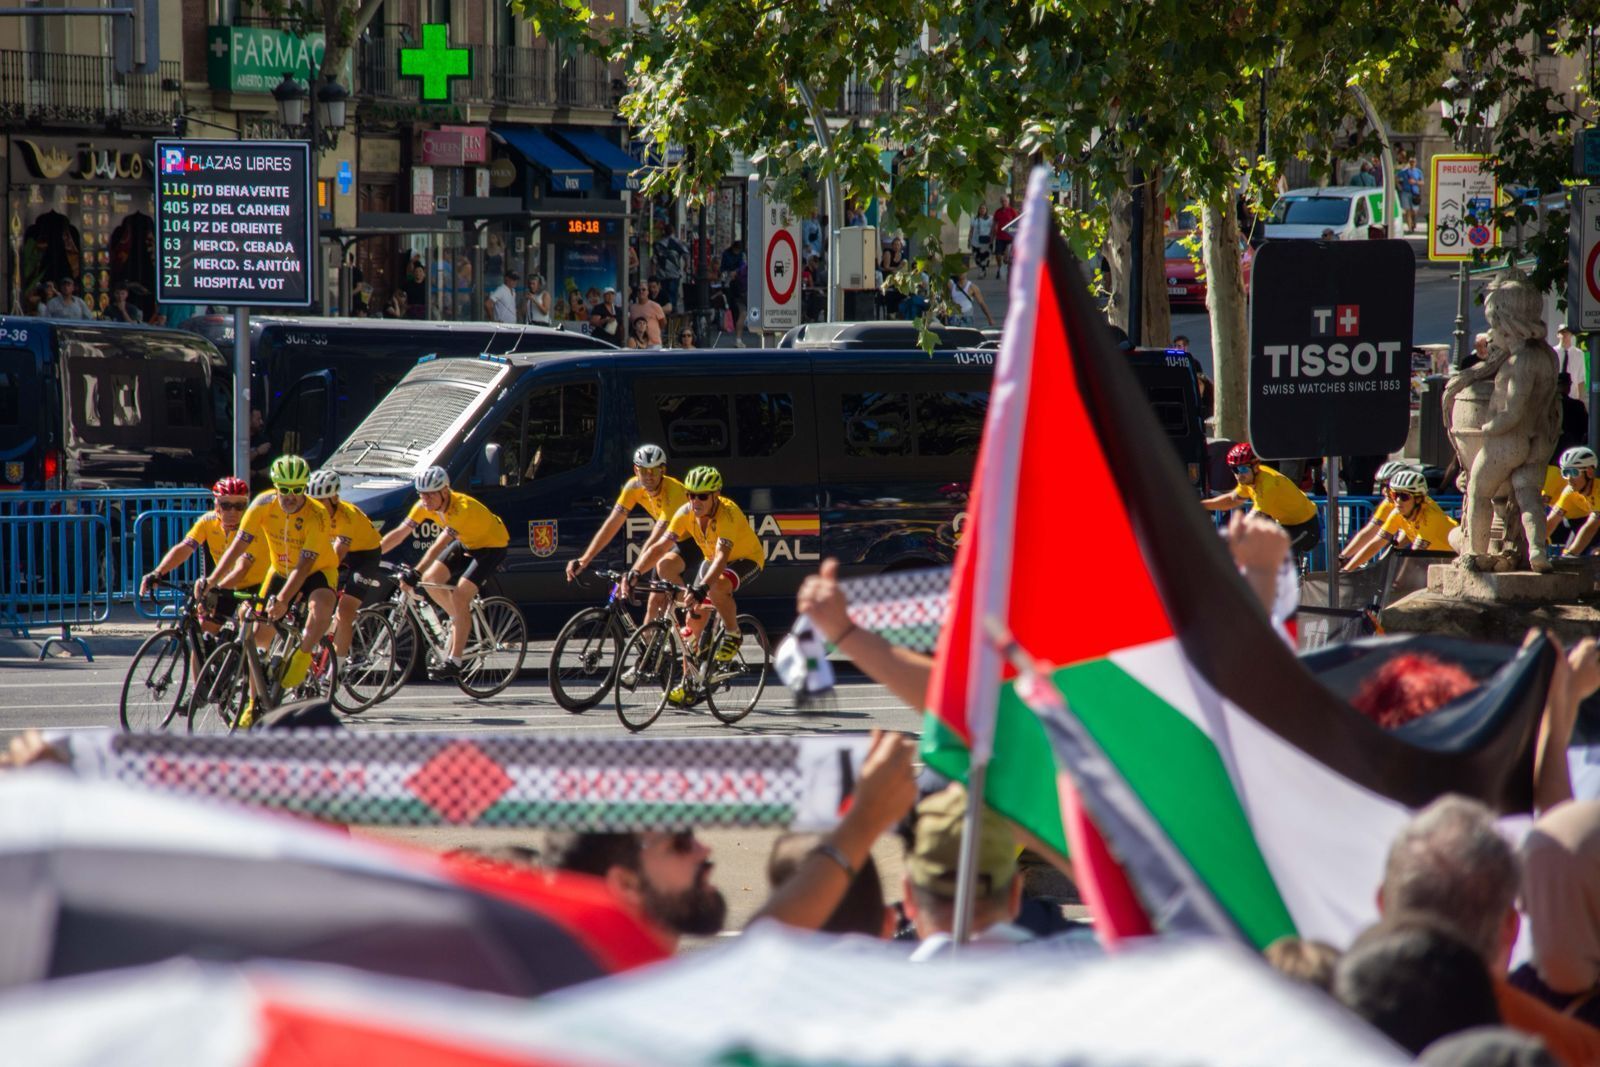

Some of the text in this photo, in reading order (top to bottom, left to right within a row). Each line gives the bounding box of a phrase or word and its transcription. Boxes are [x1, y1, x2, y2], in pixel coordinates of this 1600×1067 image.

[233, 32, 326, 71] FARMAC
[189, 155, 292, 172] PLAZAS LIBRES
[1442, 165, 1481, 174] PRECAUC
[163, 183, 290, 198] 110 JTO BENAVENTE
[163, 201, 290, 217] 405 PZ DEL CARMEN
[163, 219, 283, 235] 104 PZ DE ORIENTE
[163, 237, 295, 254] 63 MERCD. CEBADA
[163, 256, 182, 269] 52
[193, 258, 240, 271] MERCD.
[163, 274, 286, 290] 21 HOSPITAL VOT
[953, 352, 994, 365] 1U-110
[1263, 341, 1402, 378] TISSOT
[1262, 384, 1296, 396] SWISS
[1299, 382, 1347, 394] WATCHES
[1348, 381, 1377, 393] SINCE
[420, 521, 442, 539] 09
